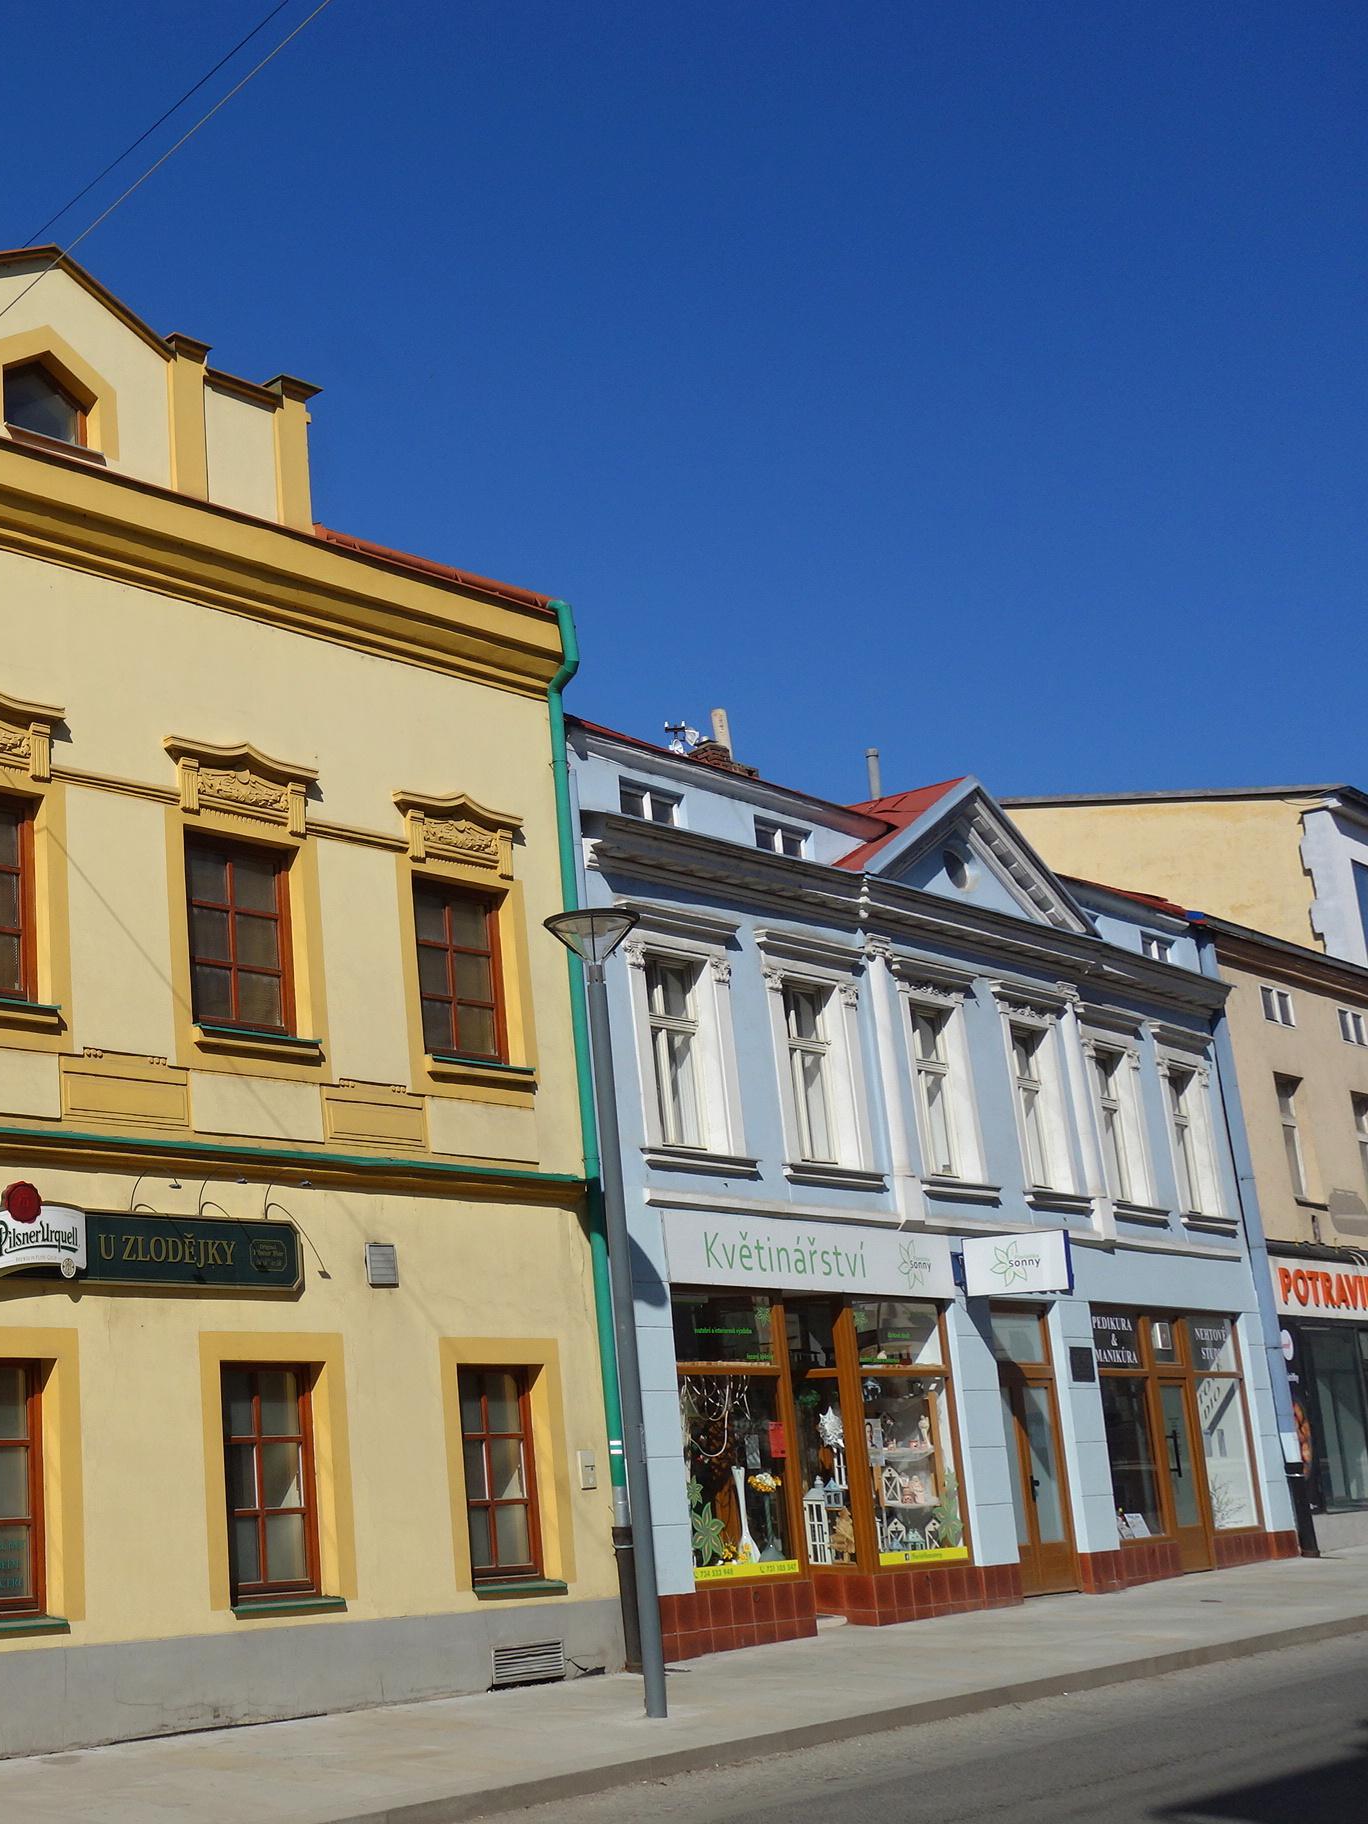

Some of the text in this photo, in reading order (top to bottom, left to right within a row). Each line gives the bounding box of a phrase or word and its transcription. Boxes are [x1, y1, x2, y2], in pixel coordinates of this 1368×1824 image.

[39, 1220, 79, 1252] Urquell
[99, 1234, 116, 1260] U
[122, 1233, 236, 1268] ZLODĚJKY
[704, 1231, 866, 1278] Květinářství
[1278, 1267, 1368, 1310] POTRAVI
[1111, 1333, 1118, 1346] &
[1194, 1326, 1227, 1342] NEHTOVÉ
[1095, 1346, 1139, 1364] MANIKÚRA
[1201, 1347, 1223, 1360] STUD
